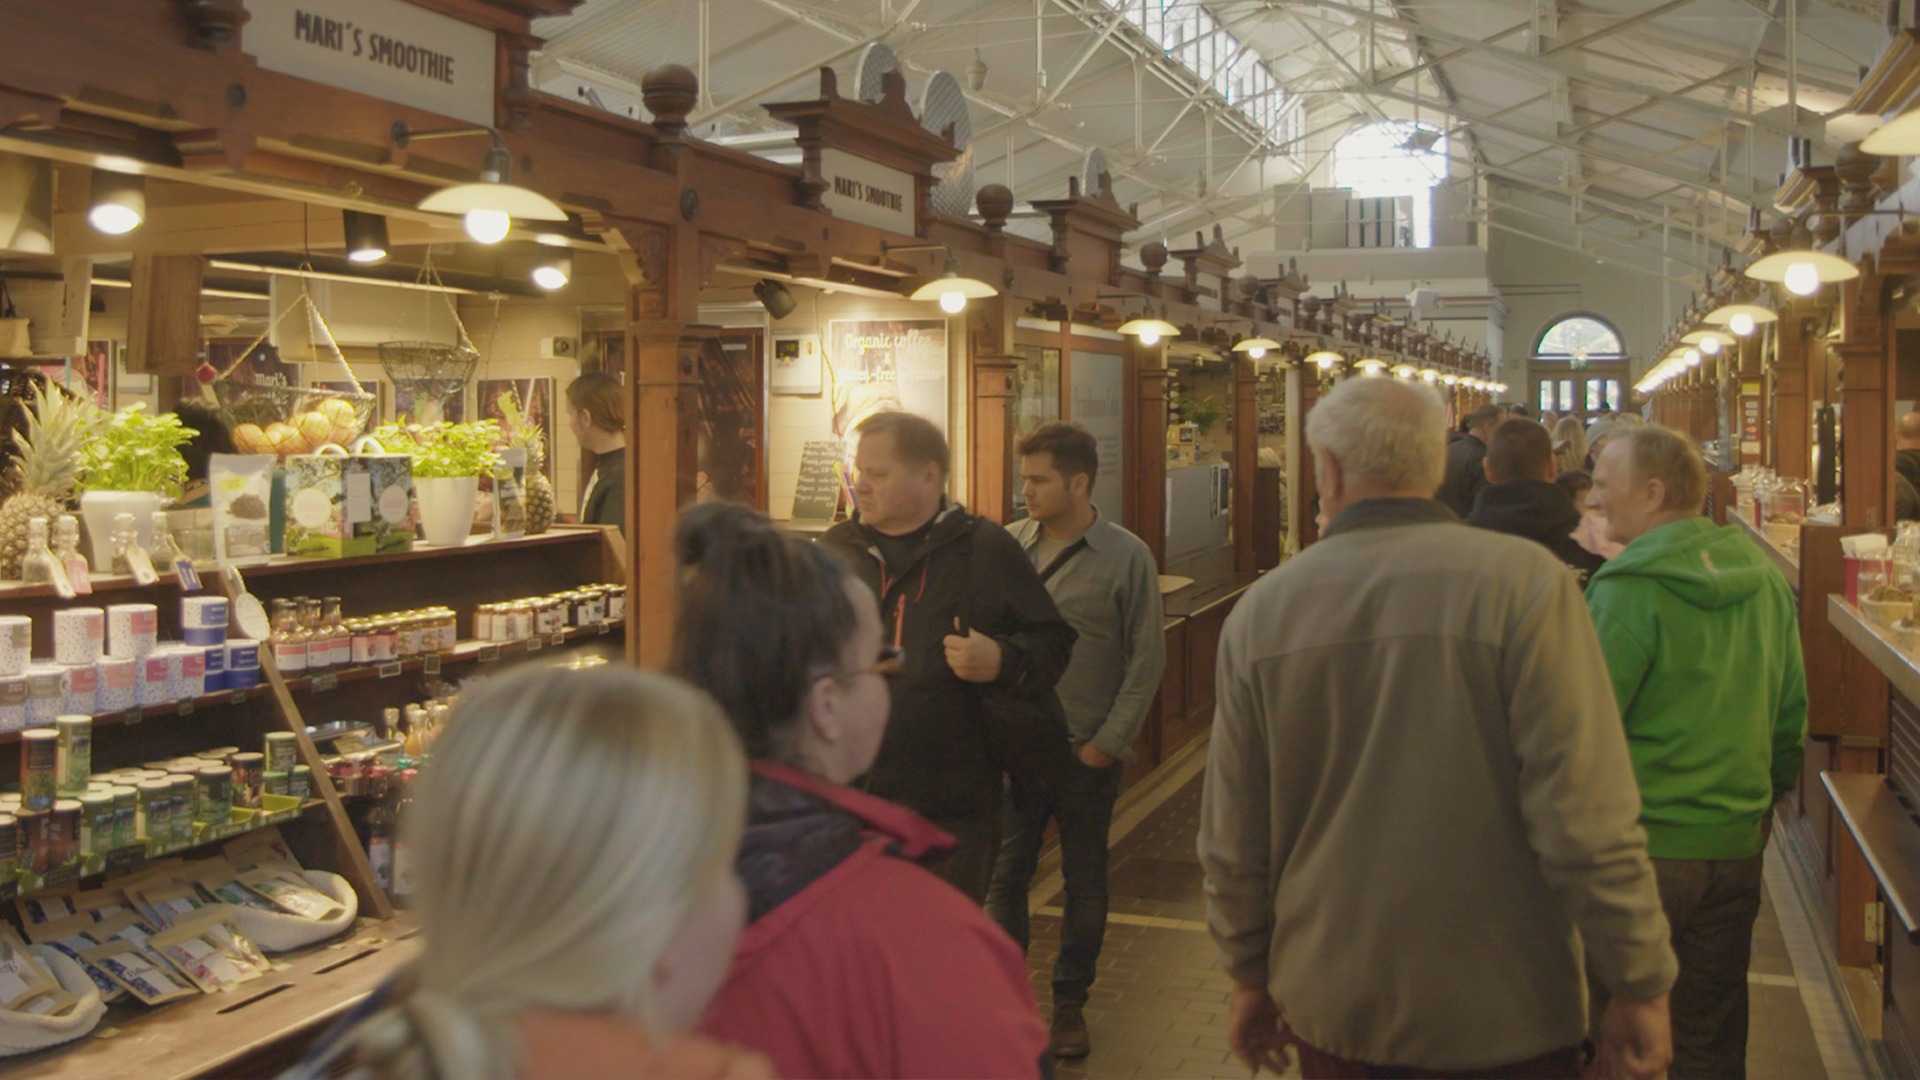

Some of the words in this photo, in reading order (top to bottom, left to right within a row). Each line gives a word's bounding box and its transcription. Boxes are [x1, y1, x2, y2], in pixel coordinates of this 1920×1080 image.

[294, 9, 364, 57] MARI'S
[369, 33, 455, 85] SMOOTHIE
[834, 175, 862, 201] MARI'S
[865, 185, 903, 213] SMOOTHIE
[846, 334, 892, 354] Organic
[894, 328, 933, 353] coffee
